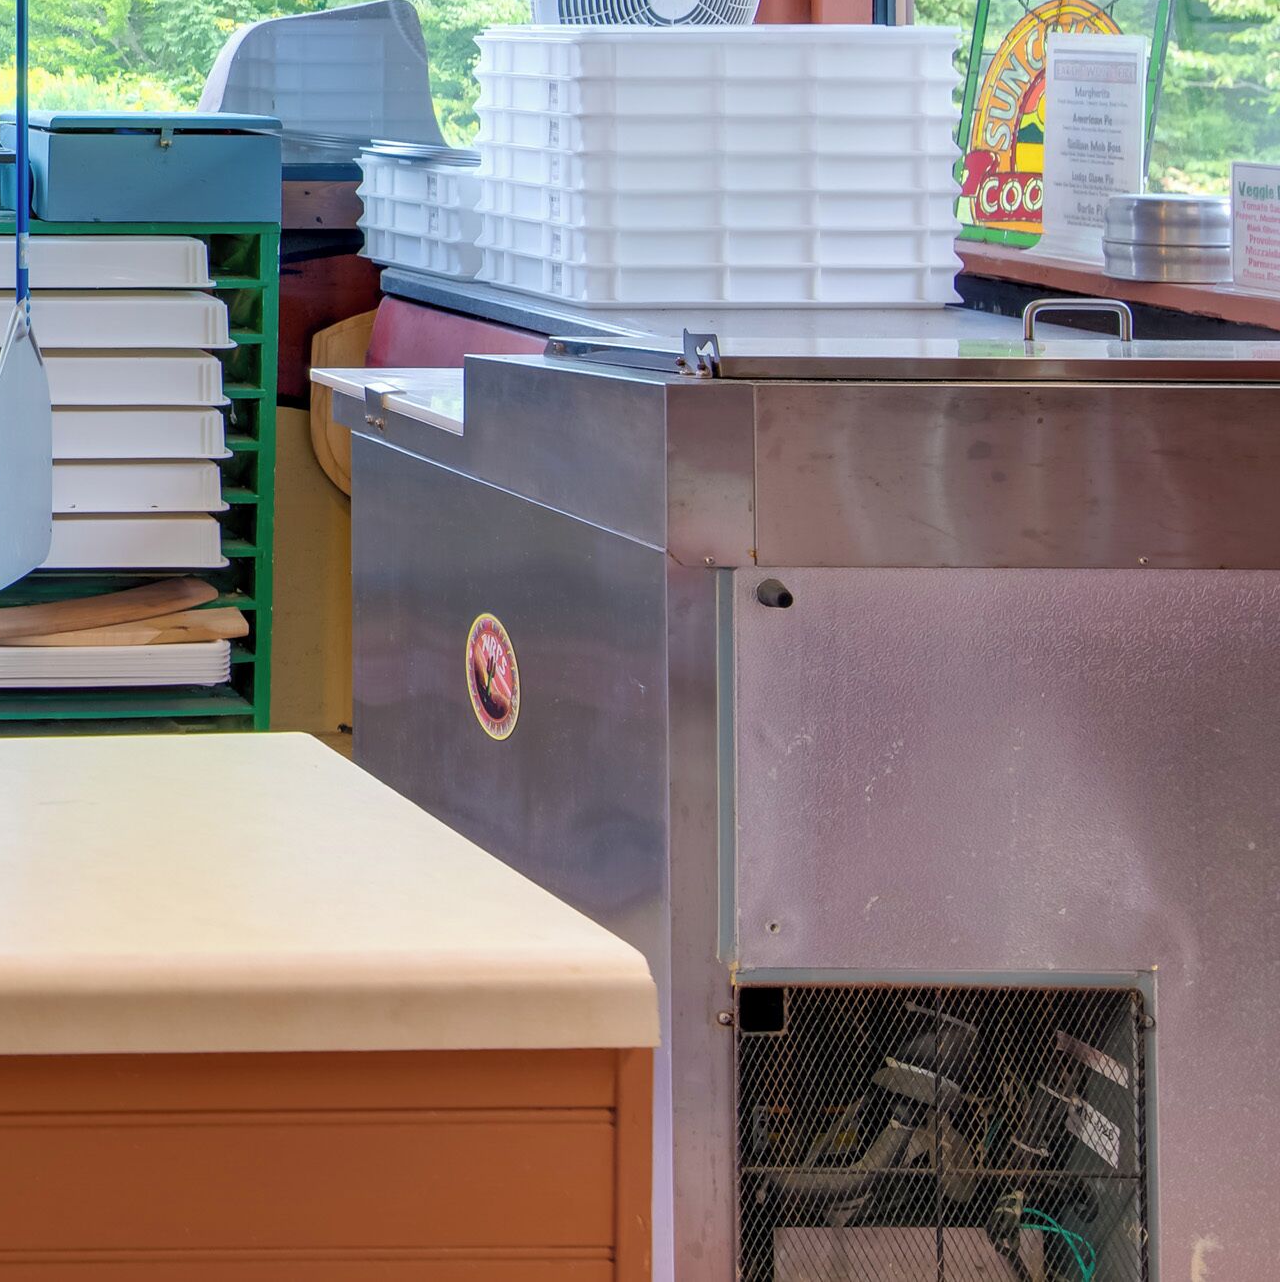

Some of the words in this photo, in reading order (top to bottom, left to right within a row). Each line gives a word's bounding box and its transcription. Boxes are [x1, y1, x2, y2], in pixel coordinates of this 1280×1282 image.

[1072, 113, 1103, 125] American
[1238, 180, 1275, 201] Veggie
[1241, 200, 1268, 212] Tomato
